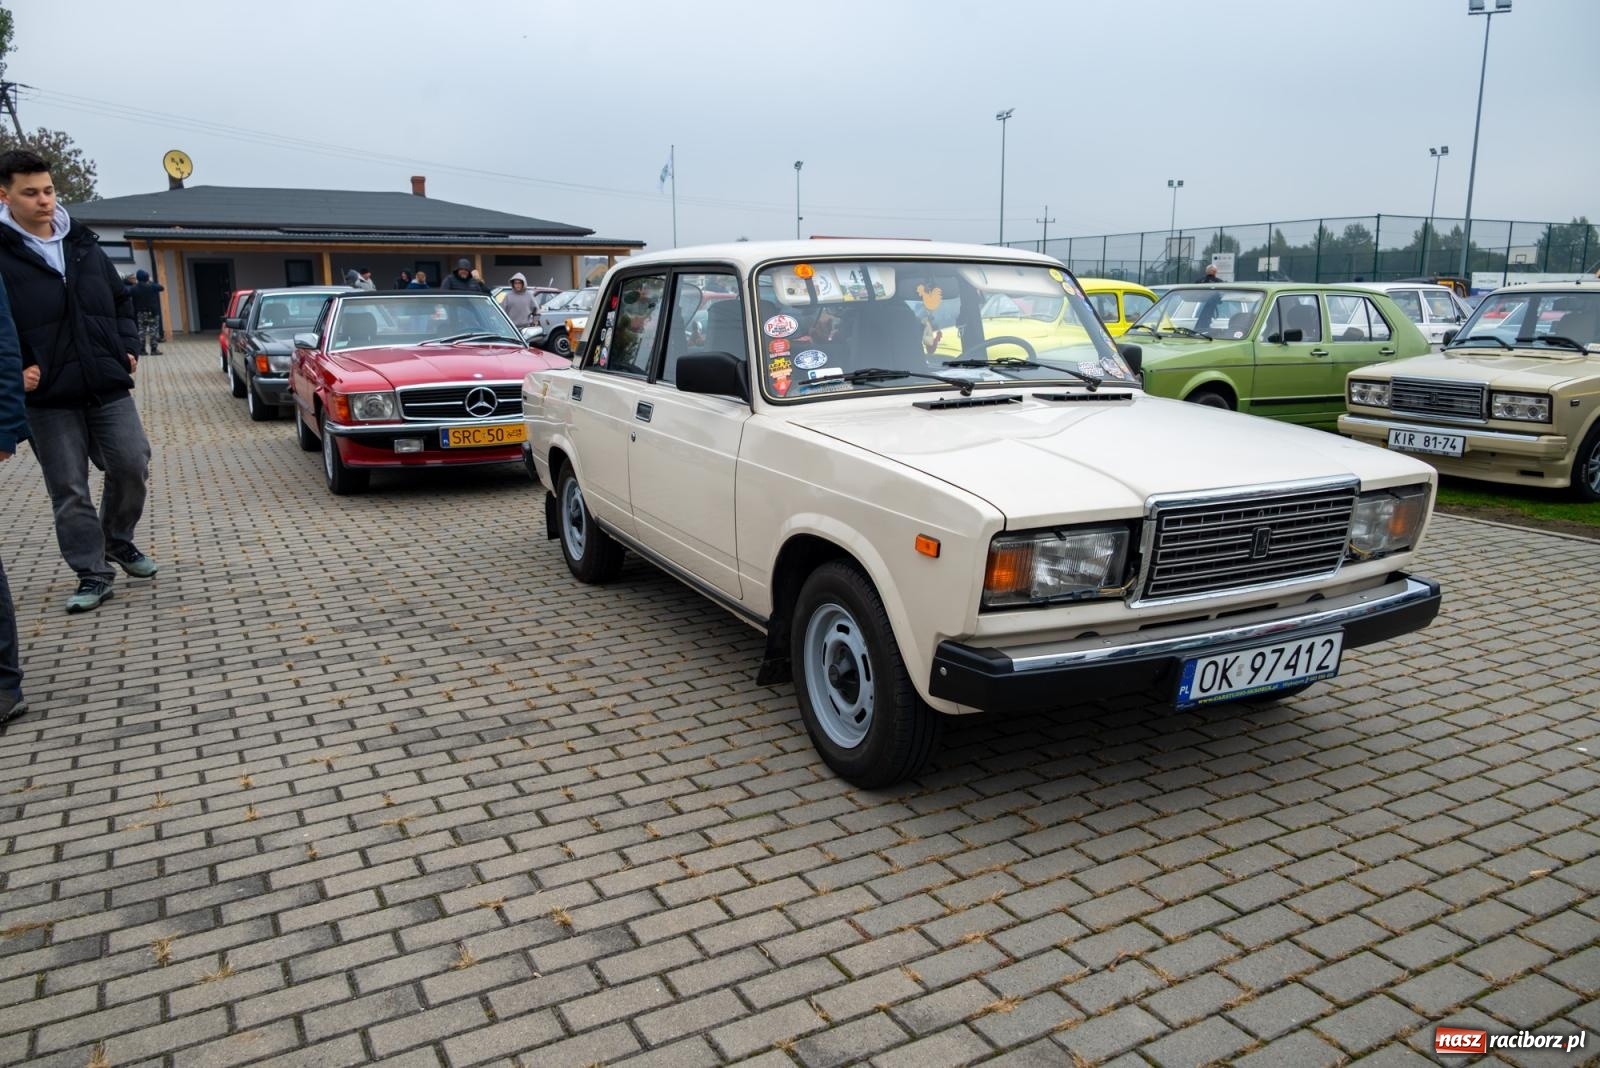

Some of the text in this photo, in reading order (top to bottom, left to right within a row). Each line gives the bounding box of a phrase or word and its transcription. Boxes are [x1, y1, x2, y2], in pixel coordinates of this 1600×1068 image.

[452, 428, 504, 444] SRC 50
[1394, 431, 1415, 446] KIR
[1423, 435, 1457, 451] 81-74
[1199, 638, 1334, 694] OK 97412
[1179, 685, 1189, 695] PL
